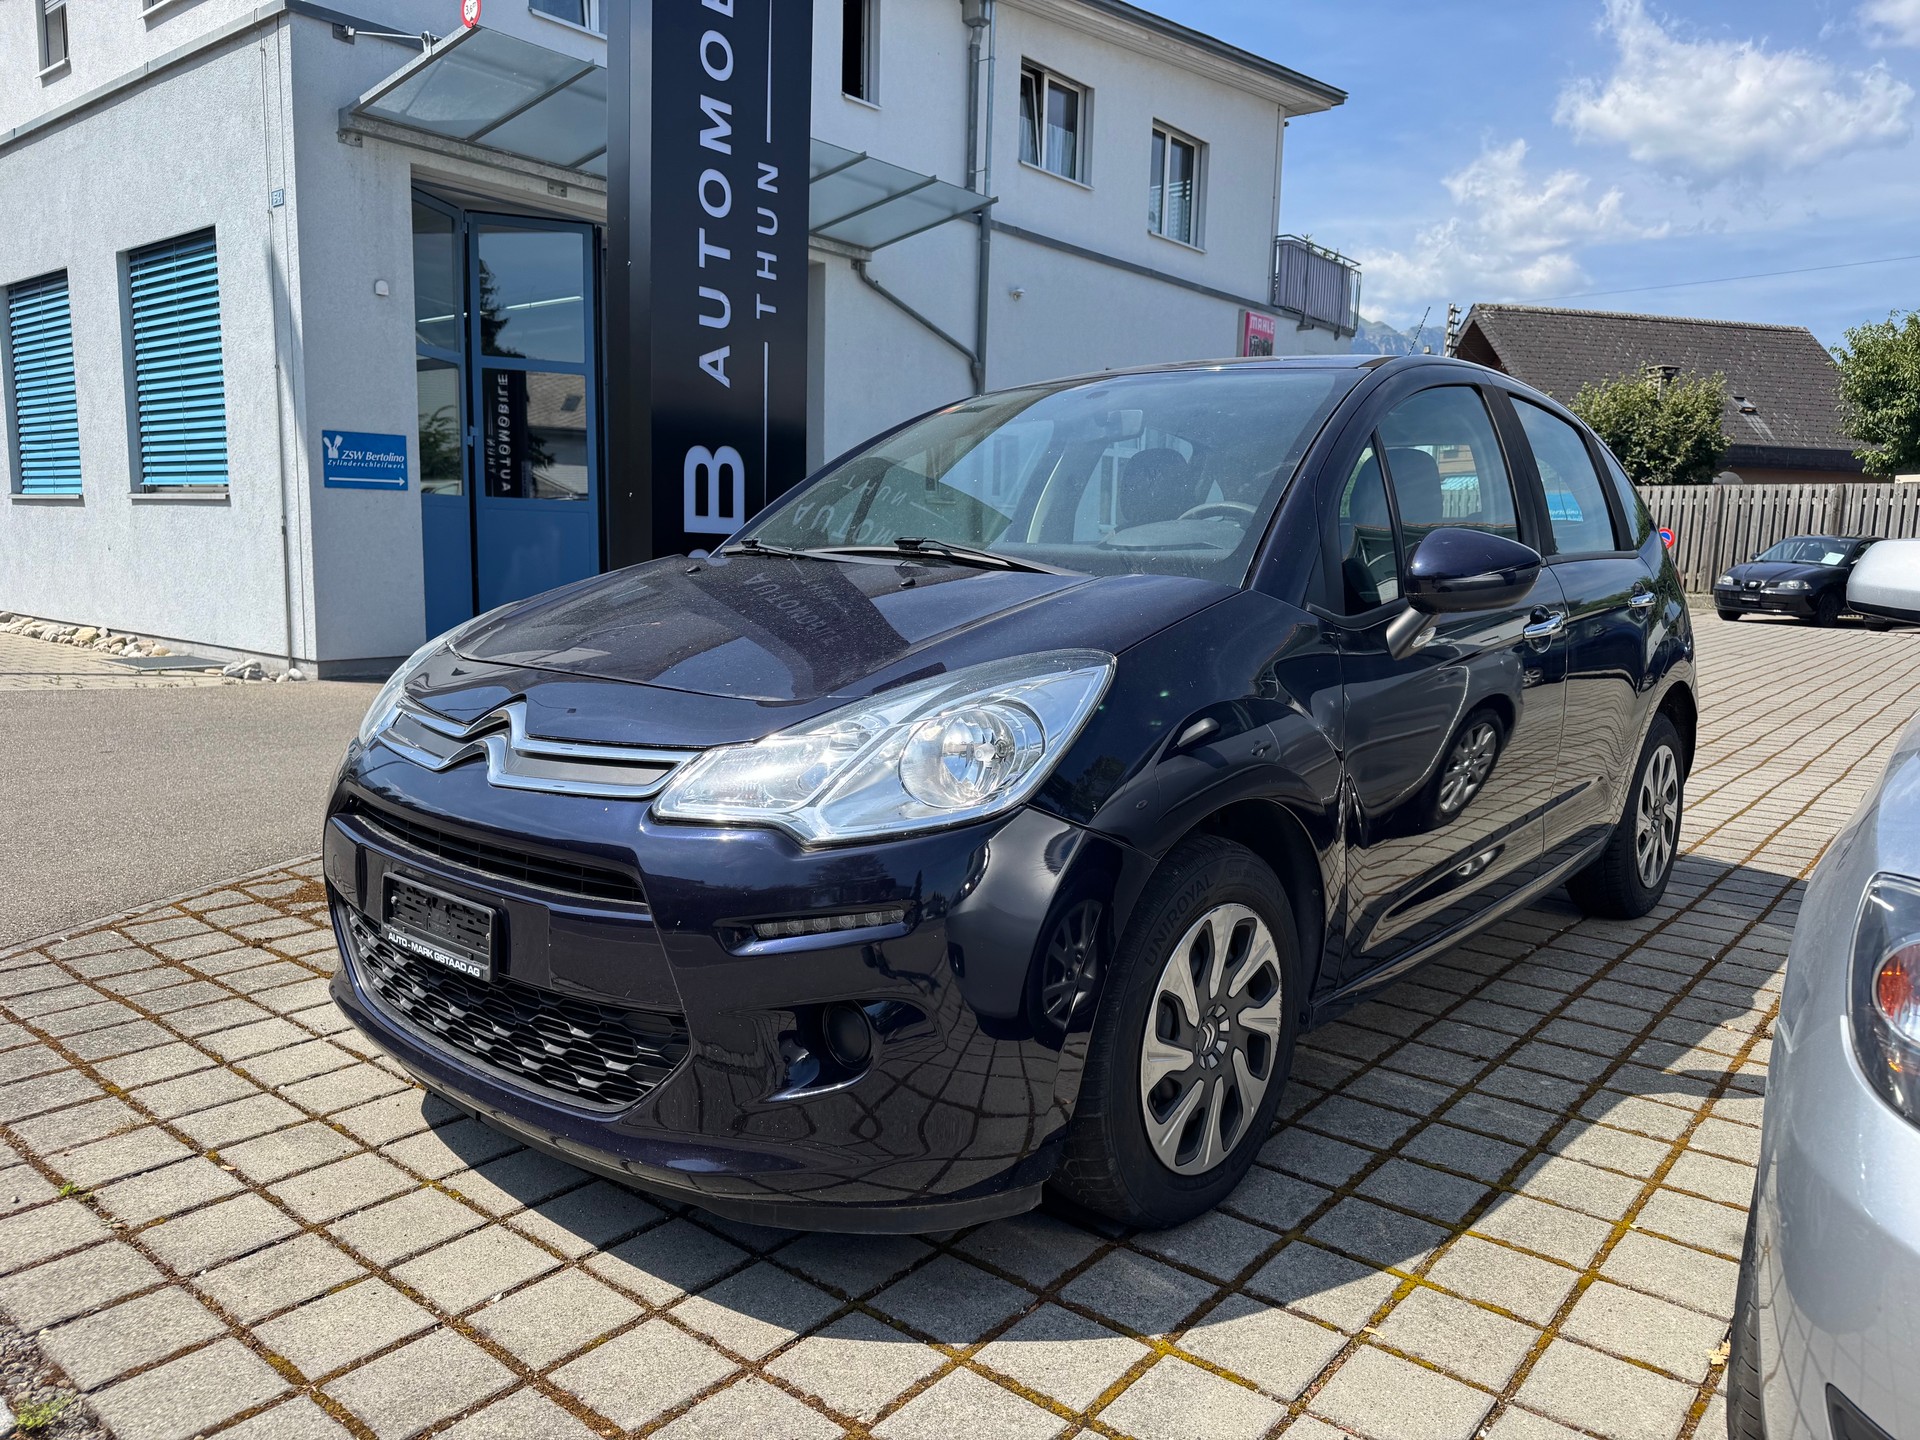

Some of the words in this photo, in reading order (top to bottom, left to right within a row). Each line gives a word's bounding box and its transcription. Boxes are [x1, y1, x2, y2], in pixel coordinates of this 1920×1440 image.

[756, 161, 779, 320] THUN
[1250, 315, 1274, 335] MAHLE
[327, 459, 405, 470] Zylinderschleifwerk
[341, 450, 364, 460] ZSW
[366, 451, 405, 463] Bertolino
[1144, 873, 1215, 968] UNIROYAL
[388, 932, 408, 947] AUTO
[411, 941, 434, 959] MARK
[433, 952, 467, 972] GSTAAD
[467, 966, 480, 978] AG
